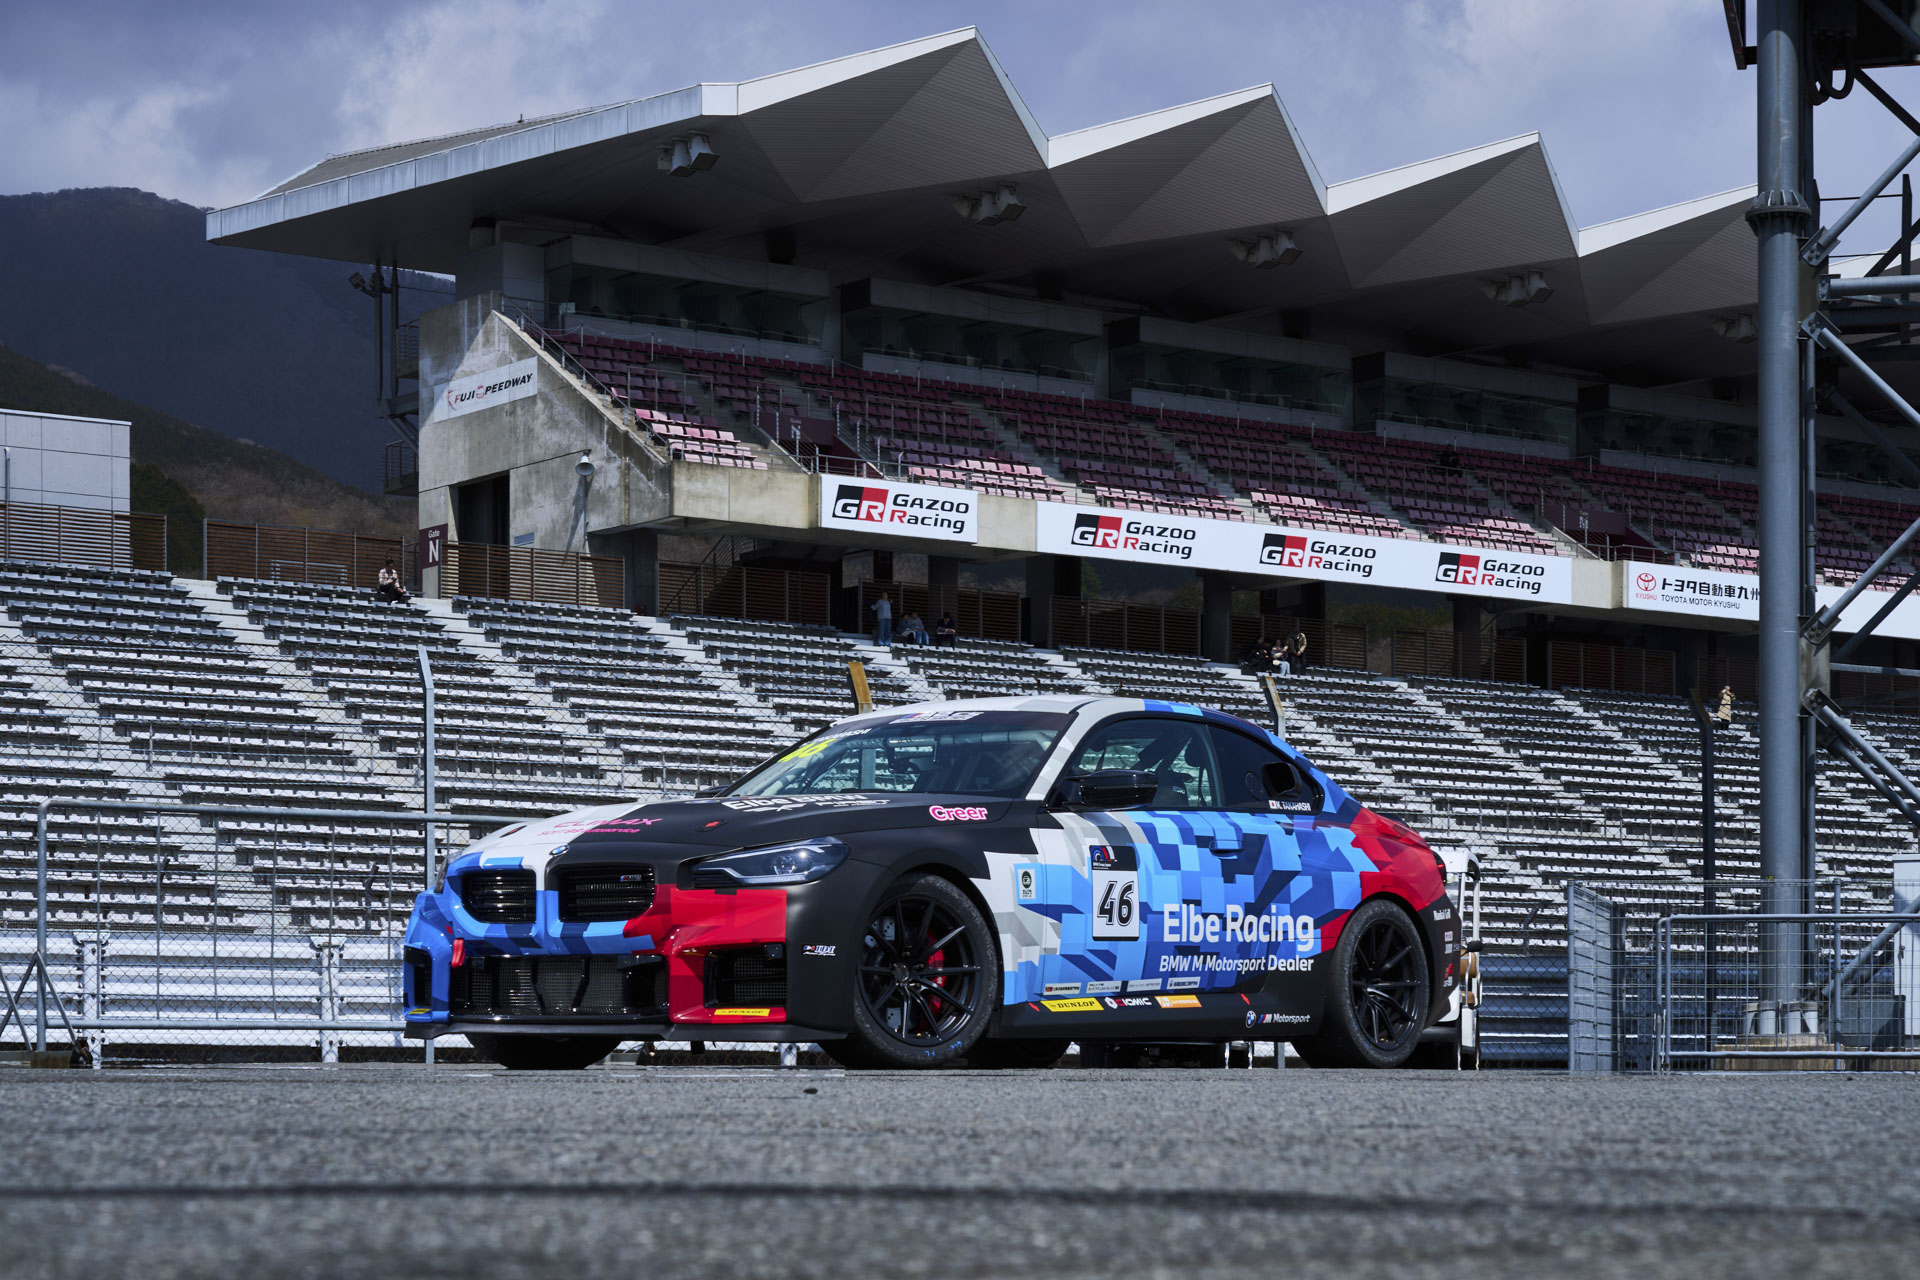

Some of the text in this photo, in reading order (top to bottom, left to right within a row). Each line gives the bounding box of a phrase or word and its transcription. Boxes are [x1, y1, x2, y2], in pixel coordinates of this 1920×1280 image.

[454, 390, 476, 404] FUJI
[893, 493, 969, 514] GAZOO
[889, 509, 965, 534] Racing
[1126, 521, 1196, 540] GAZOO
[428, 530, 440, 539] Gate
[429, 539, 439, 563] N
[1123, 536, 1192, 560] Racing
[1311, 541, 1376, 559] GAZOO
[1308, 555, 1373, 578] Racing
[1483, 559, 1545, 576] GAZOO
[1481, 573, 1542, 595] Racing
[1661, 578, 1759, 601] トヨタ自動車九州
[1635, 592, 1658, 601] KYUSHU
[1661, 594, 1741, 610] TOYOTA MOTOR KYUSHU
[721, 798, 793, 810] Elbe
[928, 805, 988, 821] Creer
[1097, 880, 1134, 927] 46
[1163, 903, 1315, 952] Elbe Racing
[1159, 954, 1315, 975] BMW M Motorsport Dealer
[1057, 1001, 1095, 1009] DUNLOP
[1272, 1013, 1311, 1025] Motorsport
